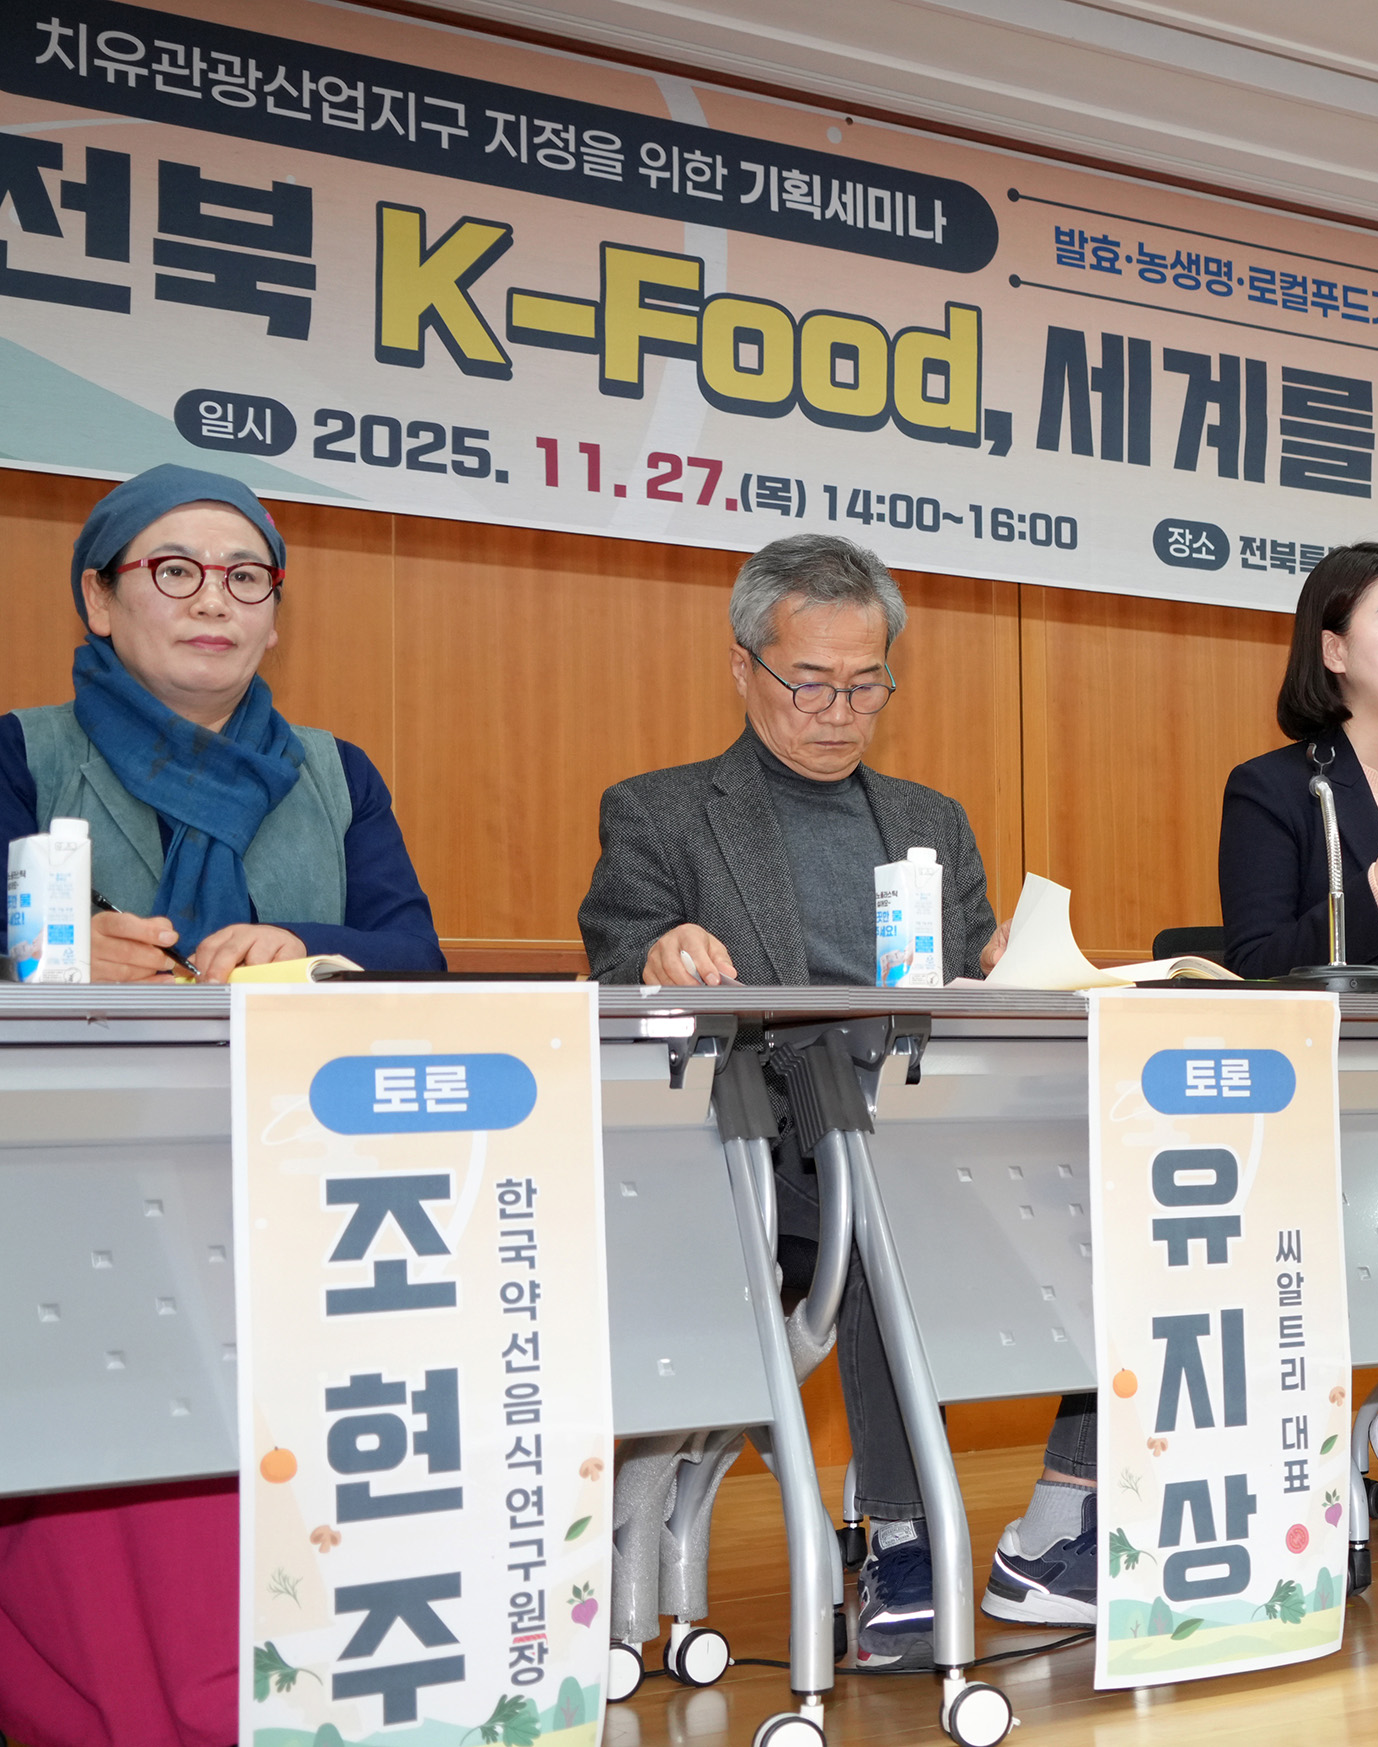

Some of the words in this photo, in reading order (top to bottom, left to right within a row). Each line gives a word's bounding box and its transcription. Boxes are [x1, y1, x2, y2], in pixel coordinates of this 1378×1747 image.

[35, 17, 470, 149] 치유관광산업지구
[484, 109, 625, 182] 지정을
[638, 140, 727, 201] 위한
[739, 160, 947, 245] 기획세미나
[0, 132, 316, 341] 전북
[375, 200, 1013, 458] K-Food,
[1036, 325, 1376, 500] 세계를
[198, 400, 273, 445] 일시
[313, 407, 509, 485] 2025.
[536, 436, 627, 499] 11.
[822, 484, 1078, 550] 14:00~16:00
[1167, 526, 1217, 562] 장소
[373, 1065, 470, 1113] 토론
[1185, 1059, 1251, 1097] 토론
[1151, 1148, 1257, 1602] 유지상
[1276, 1229, 1306, 1391] 씨알트리
[325, 1173, 466, 1726] 조현주
[495, 1178, 549, 1687] 한국약선음식연구원장
[1282, 1415, 1311, 1494] 대표
